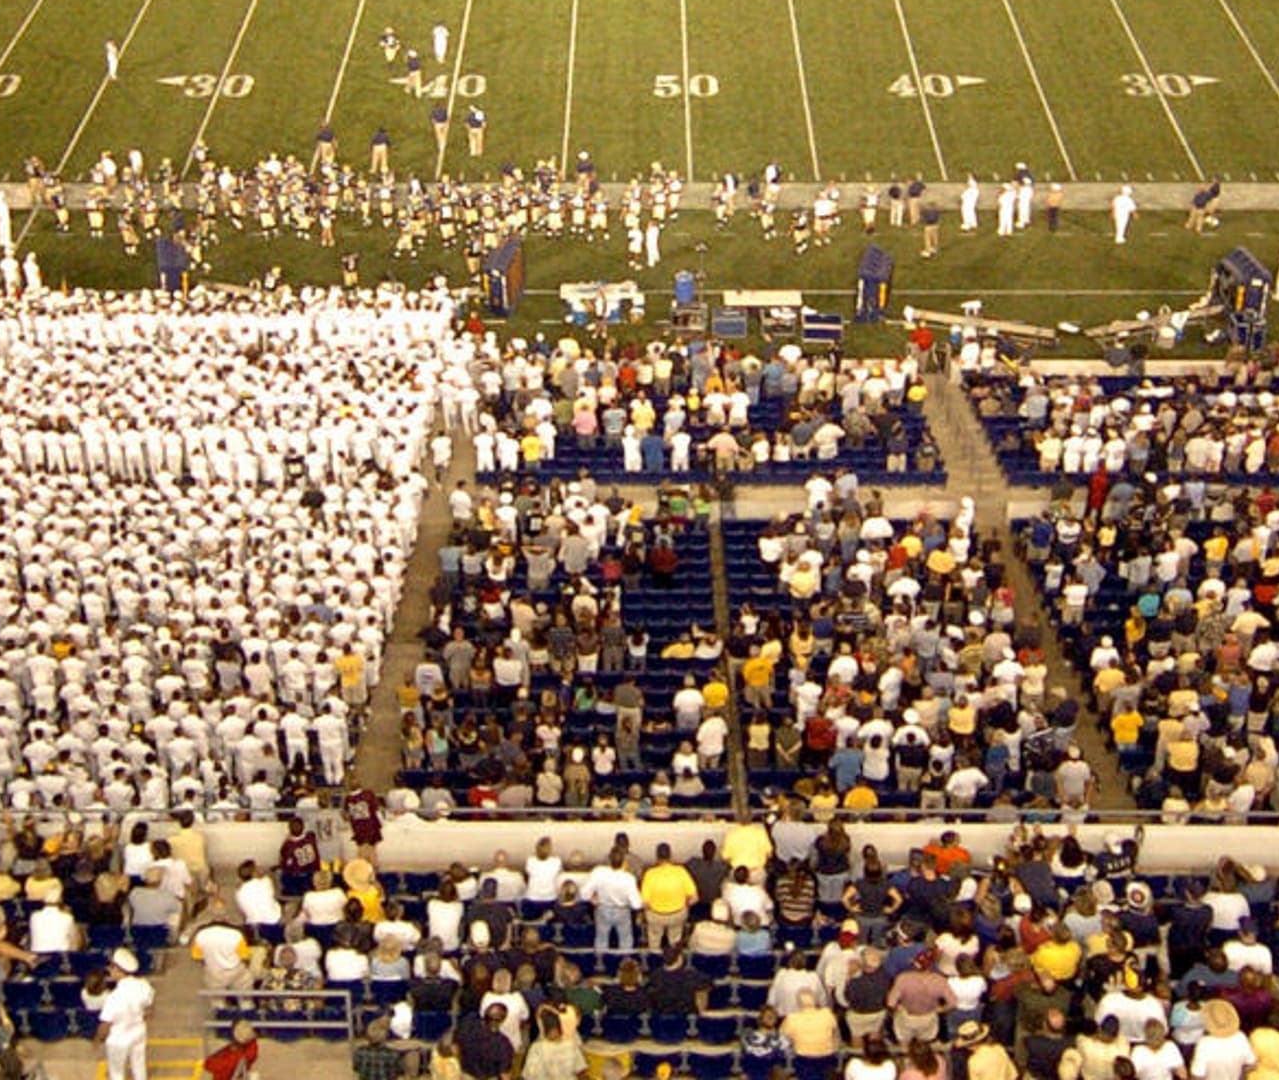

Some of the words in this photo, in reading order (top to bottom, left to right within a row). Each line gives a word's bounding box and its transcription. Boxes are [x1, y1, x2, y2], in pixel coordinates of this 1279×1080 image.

[182, 73, 256, 99] 30
[419, 73, 488, 99] 40
[652, 73, 721, 99] 50
[888, 73, 955, 99] 40
[1120, 71, 1194, 99] 30
